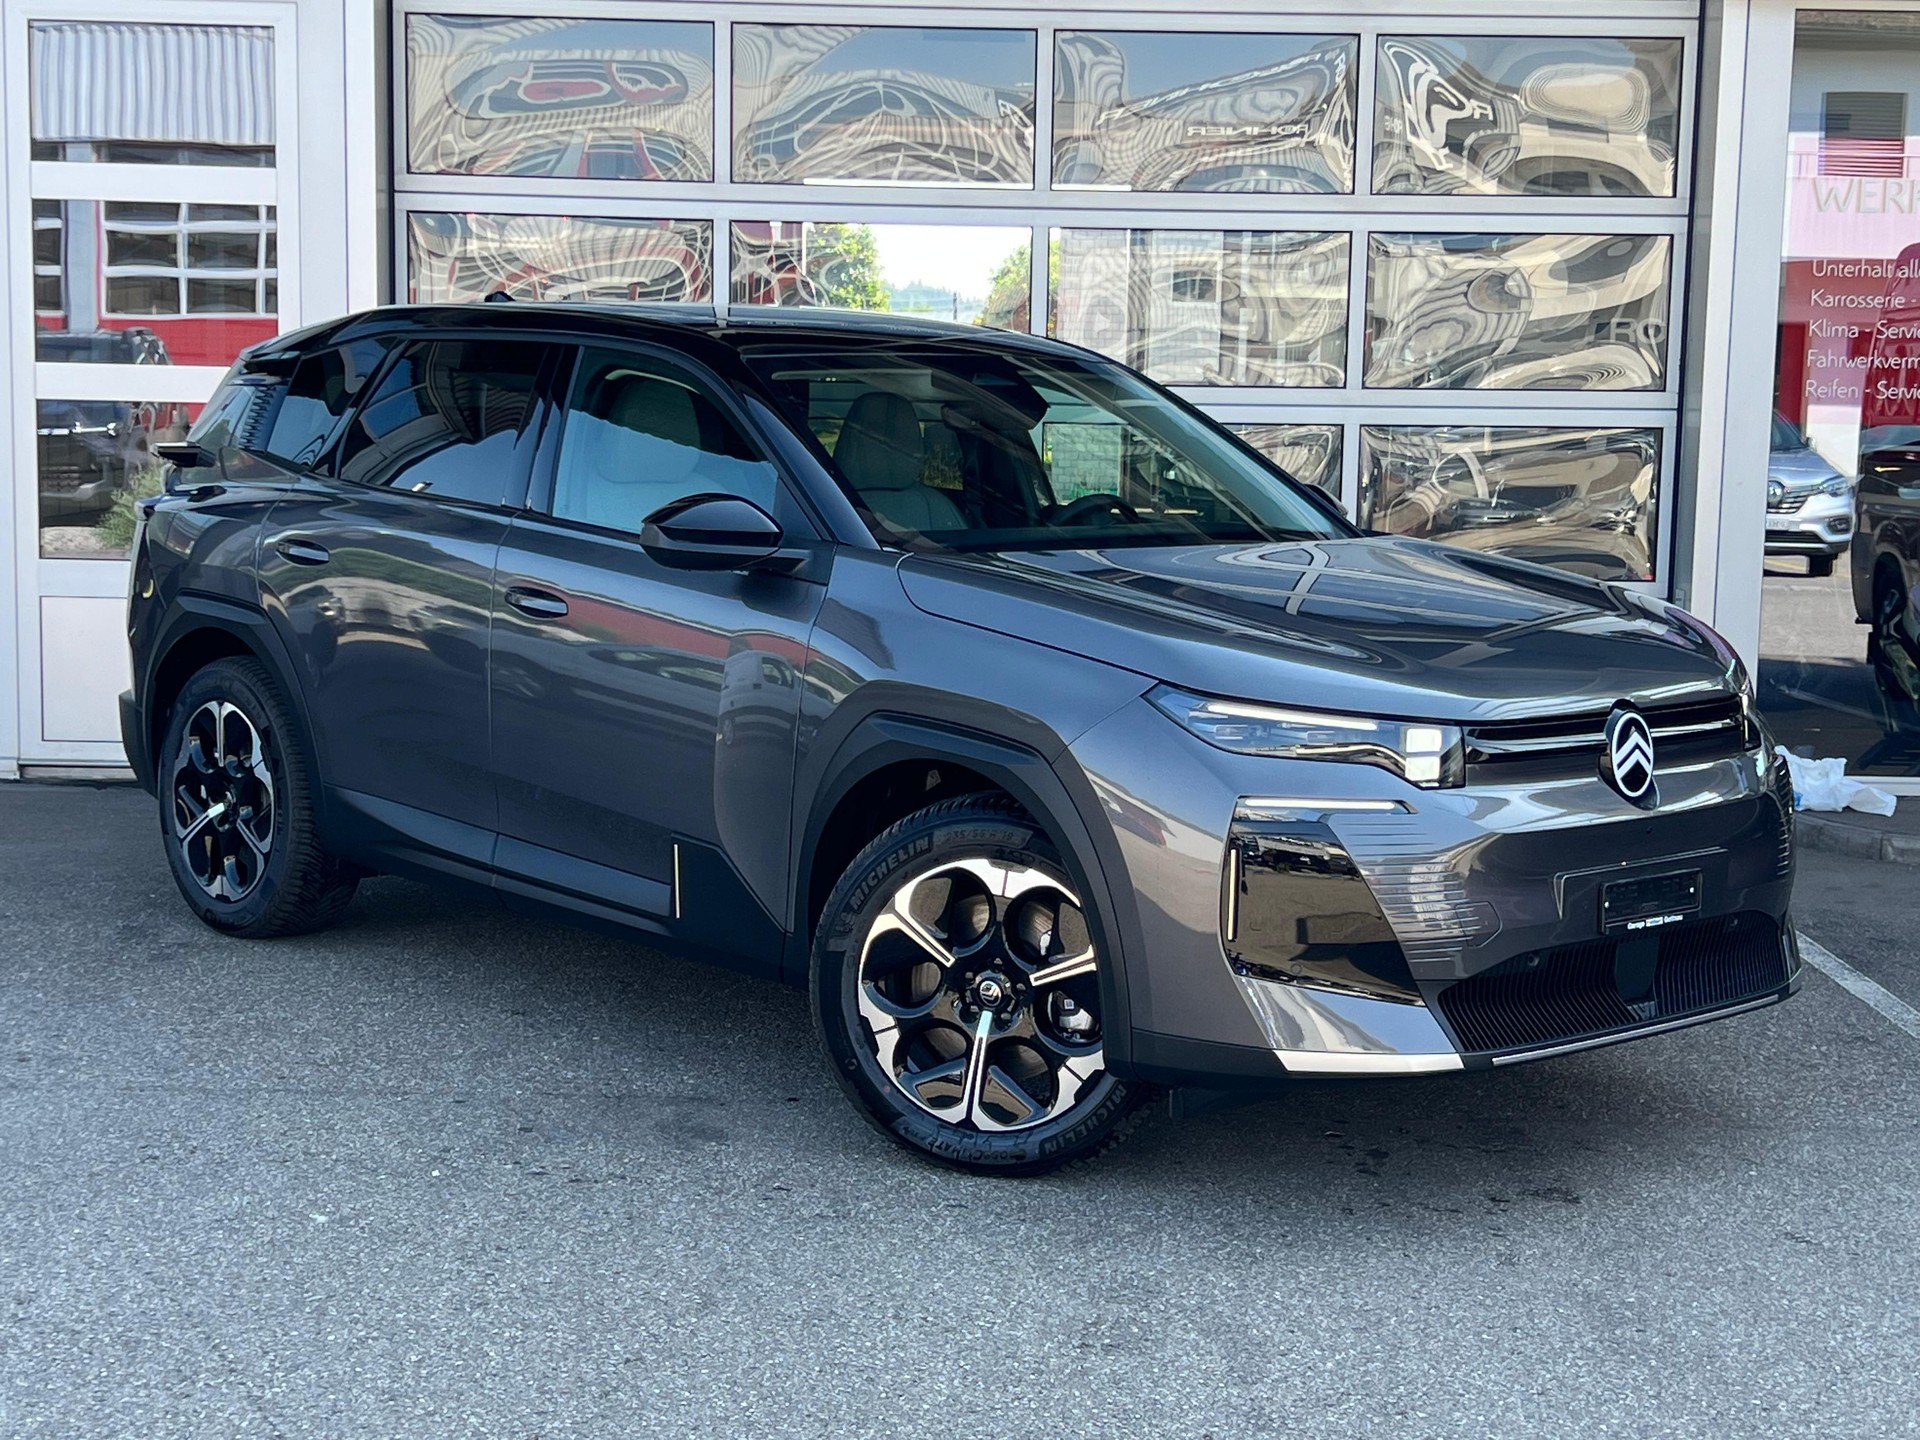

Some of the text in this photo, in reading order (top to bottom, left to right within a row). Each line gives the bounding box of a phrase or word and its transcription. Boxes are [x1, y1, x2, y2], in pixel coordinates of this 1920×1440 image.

[1812, 258, 1920, 278] Unterhalt all
[1810, 288, 1905, 308] Karrosserie
[1808, 319, 1859, 338] Klima
[1807, 349, 1920, 369] Fahrwerkverm
[1805, 378, 1858, 399] Reifen
[946, 828, 986, 841] 235/55
[849, 834, 931, 910] MICHELIN
[1044, 1083, 1126, 1154] MICHELIN
